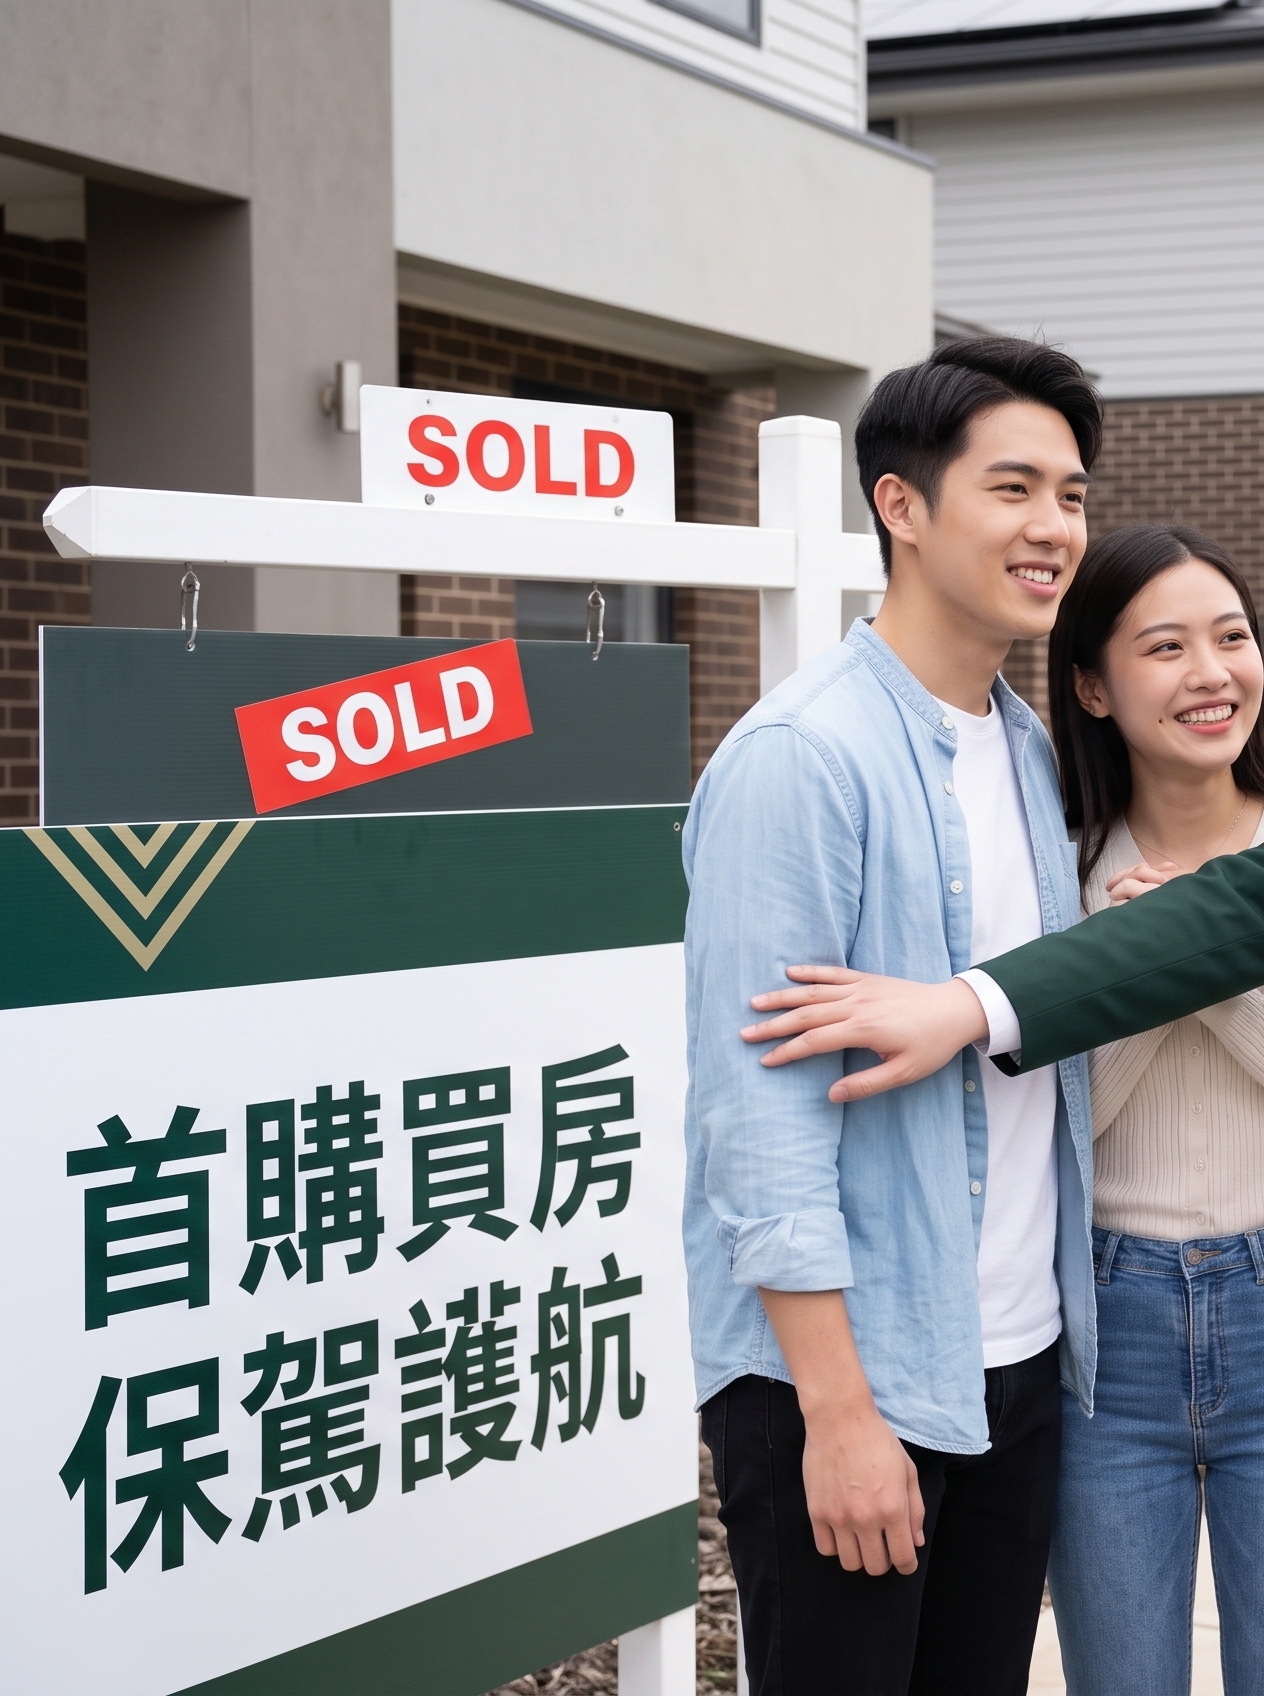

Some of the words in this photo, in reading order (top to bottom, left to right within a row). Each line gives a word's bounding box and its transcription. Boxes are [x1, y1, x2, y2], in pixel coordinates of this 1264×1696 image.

[407, 415, 635, 498] SOLD
[282, 666, 493, 781] SOLD
[67, 1044, 641, 1331] 首購買房
[59, 1252, 645, 1595] 保駕護航
